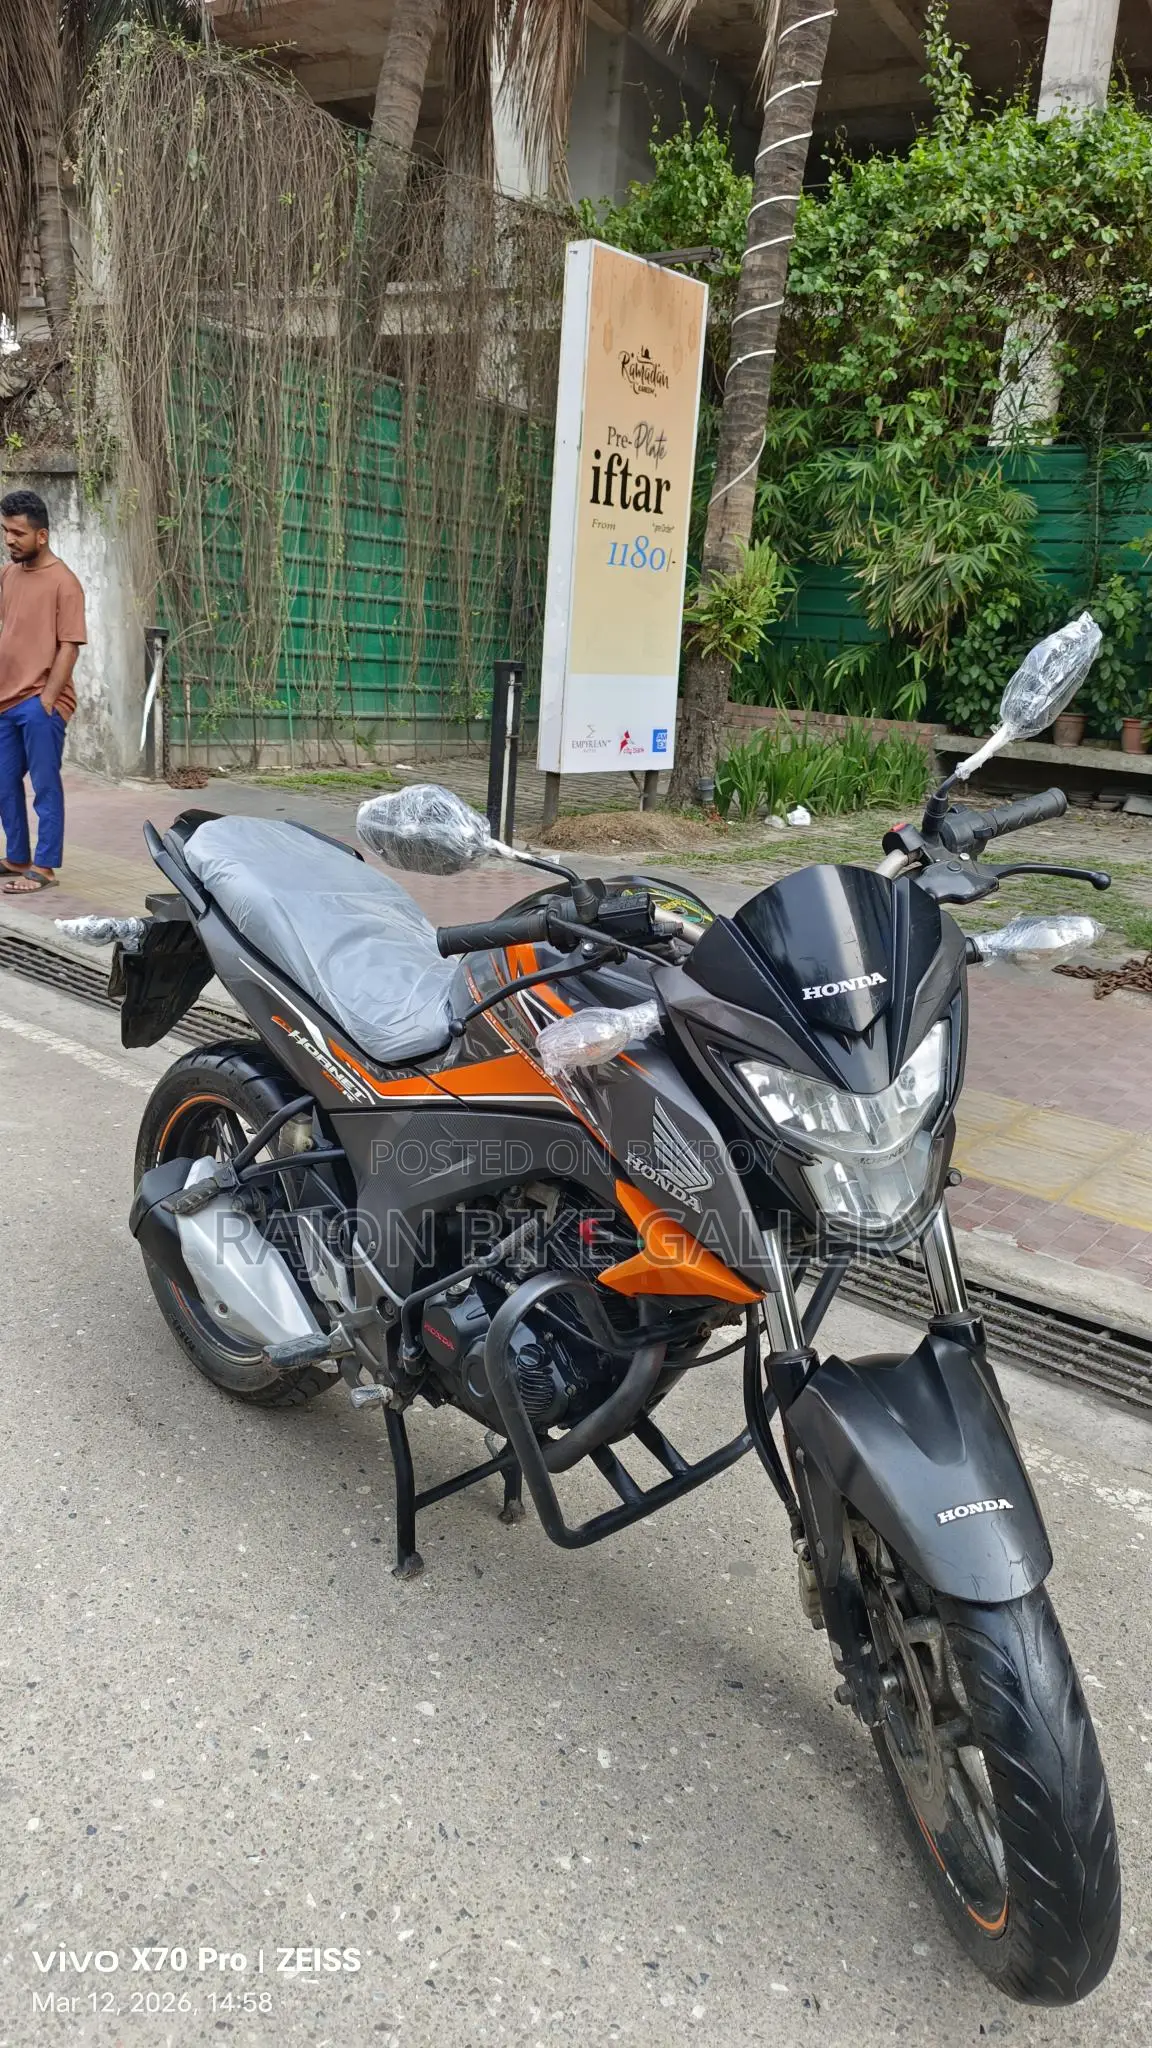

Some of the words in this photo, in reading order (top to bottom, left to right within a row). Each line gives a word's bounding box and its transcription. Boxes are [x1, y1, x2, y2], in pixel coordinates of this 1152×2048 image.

[618, 350, 669, 389] Ramadan
[590, 449, 671, 515] iftar
[592, 518, 616, 531] From
[802, 972, 887, 1000] HONDA
[288, 1029, 368, 1103] HORNET
[625, 1150, 703, 1214] HONDA
[937, 1498, 1014, 1524] HONDA
